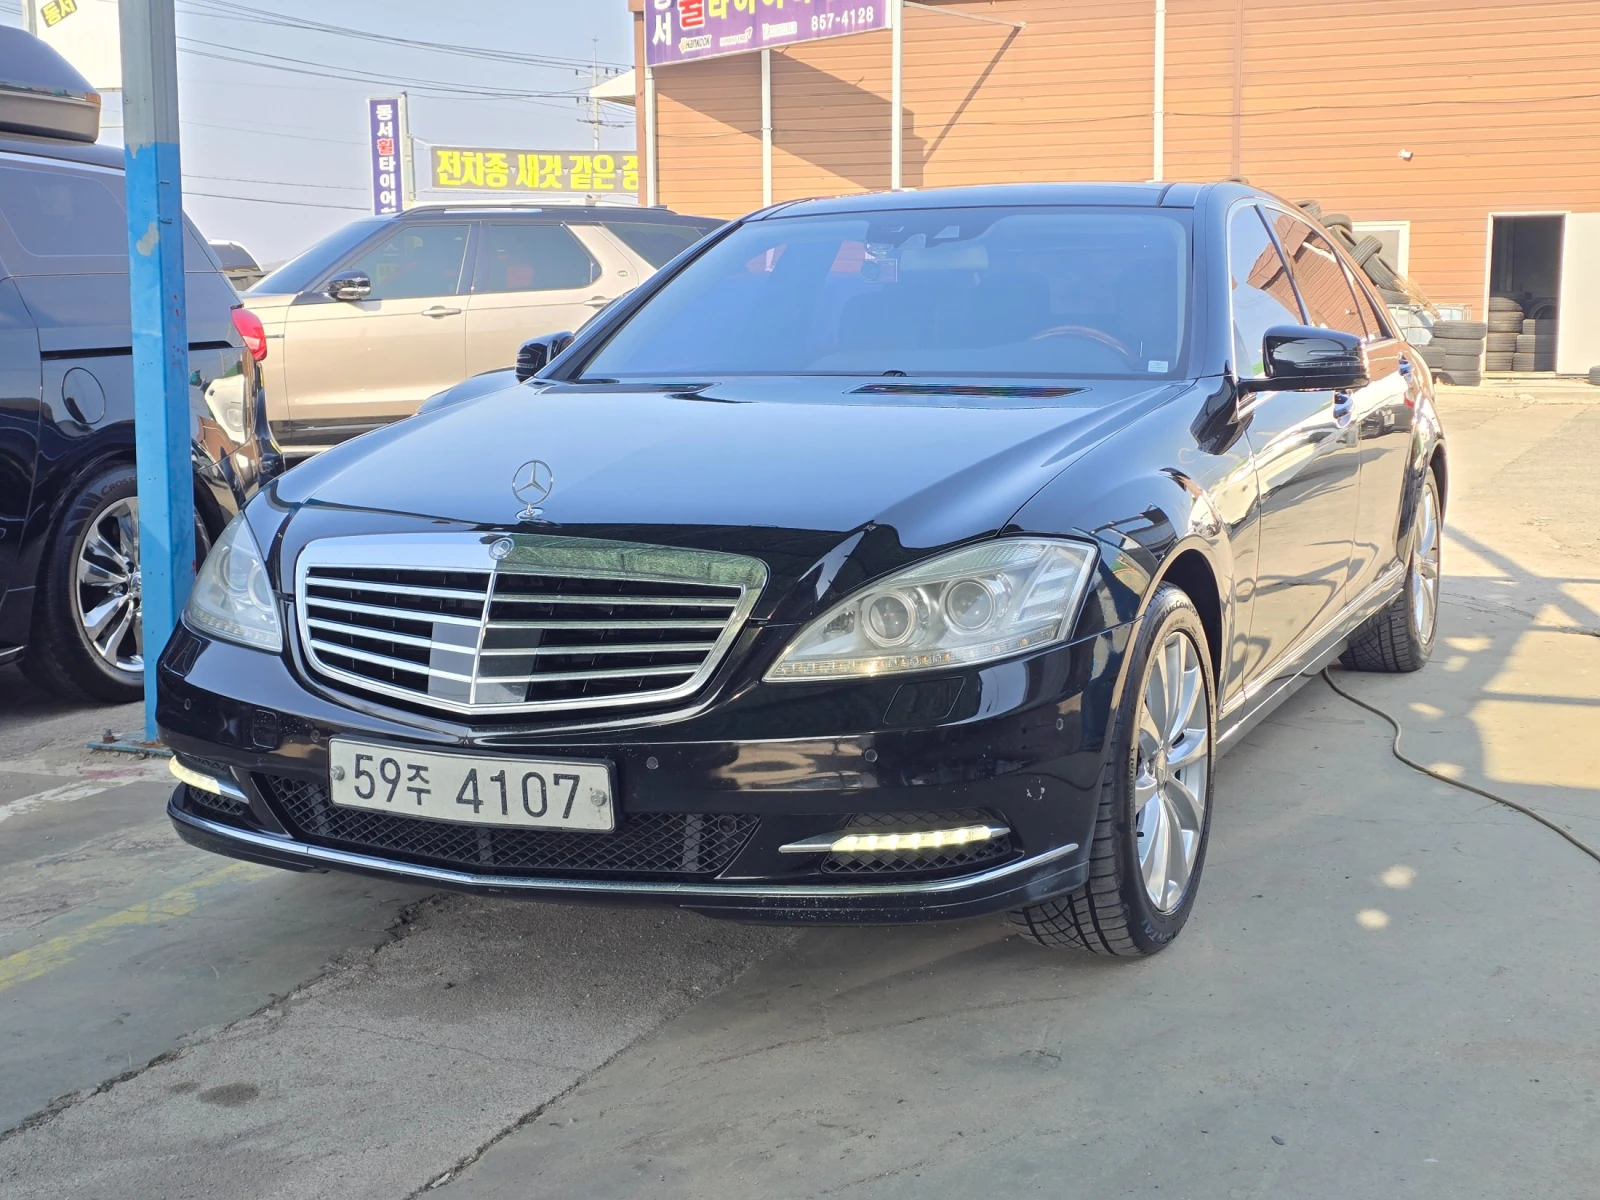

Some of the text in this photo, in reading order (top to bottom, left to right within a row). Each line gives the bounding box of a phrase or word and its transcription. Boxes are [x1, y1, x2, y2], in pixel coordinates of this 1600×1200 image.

[811, 6, 874, 31] 857-4128
[376, 104, 397, 213] 동서휠타이어
[436, 150, 508, 188] 전차종
[516, 153, 562, 189] 새것
[569, 154, 616, 190] 같은
[354, 753, 581, 819] 59주 4107
